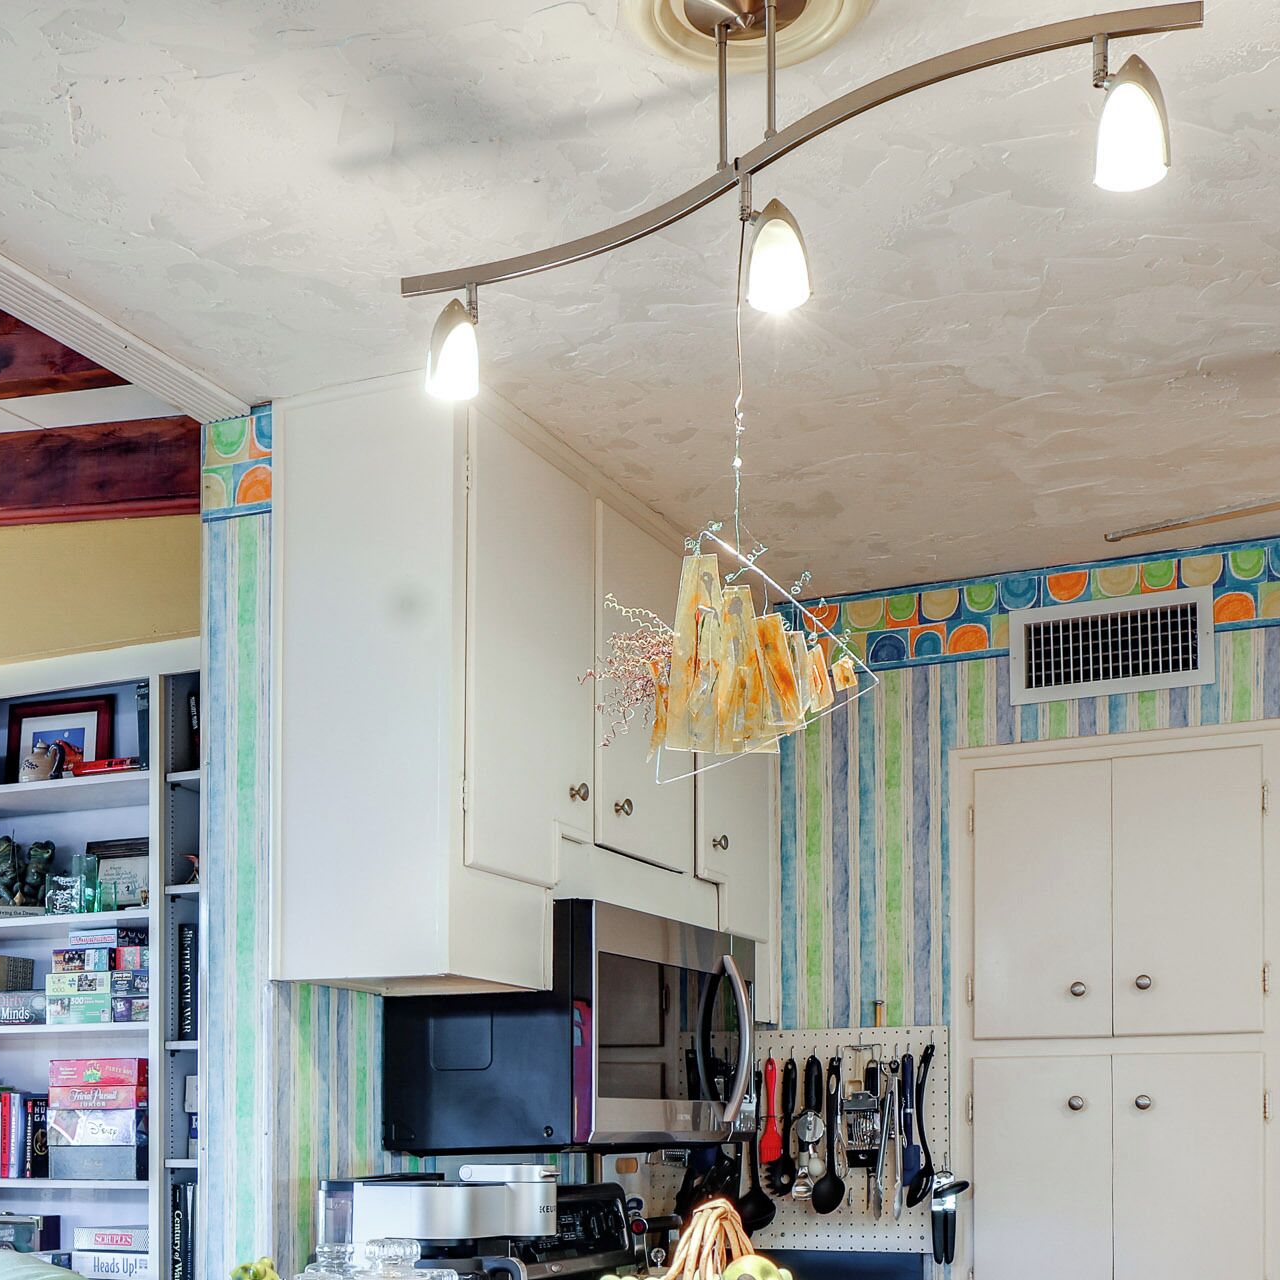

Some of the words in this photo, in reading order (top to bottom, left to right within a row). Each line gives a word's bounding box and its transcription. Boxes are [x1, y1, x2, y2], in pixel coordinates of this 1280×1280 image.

[1, 1007, 30, 1020] Minds
[182, 1007, 191, 1033] WAR
[173, 1210, 182, 1250] Century
[94, 1256, 120, 1273] Heads
[123, 1257, 137, 1277] Up!
[174, 1252, 182, 1261] of
